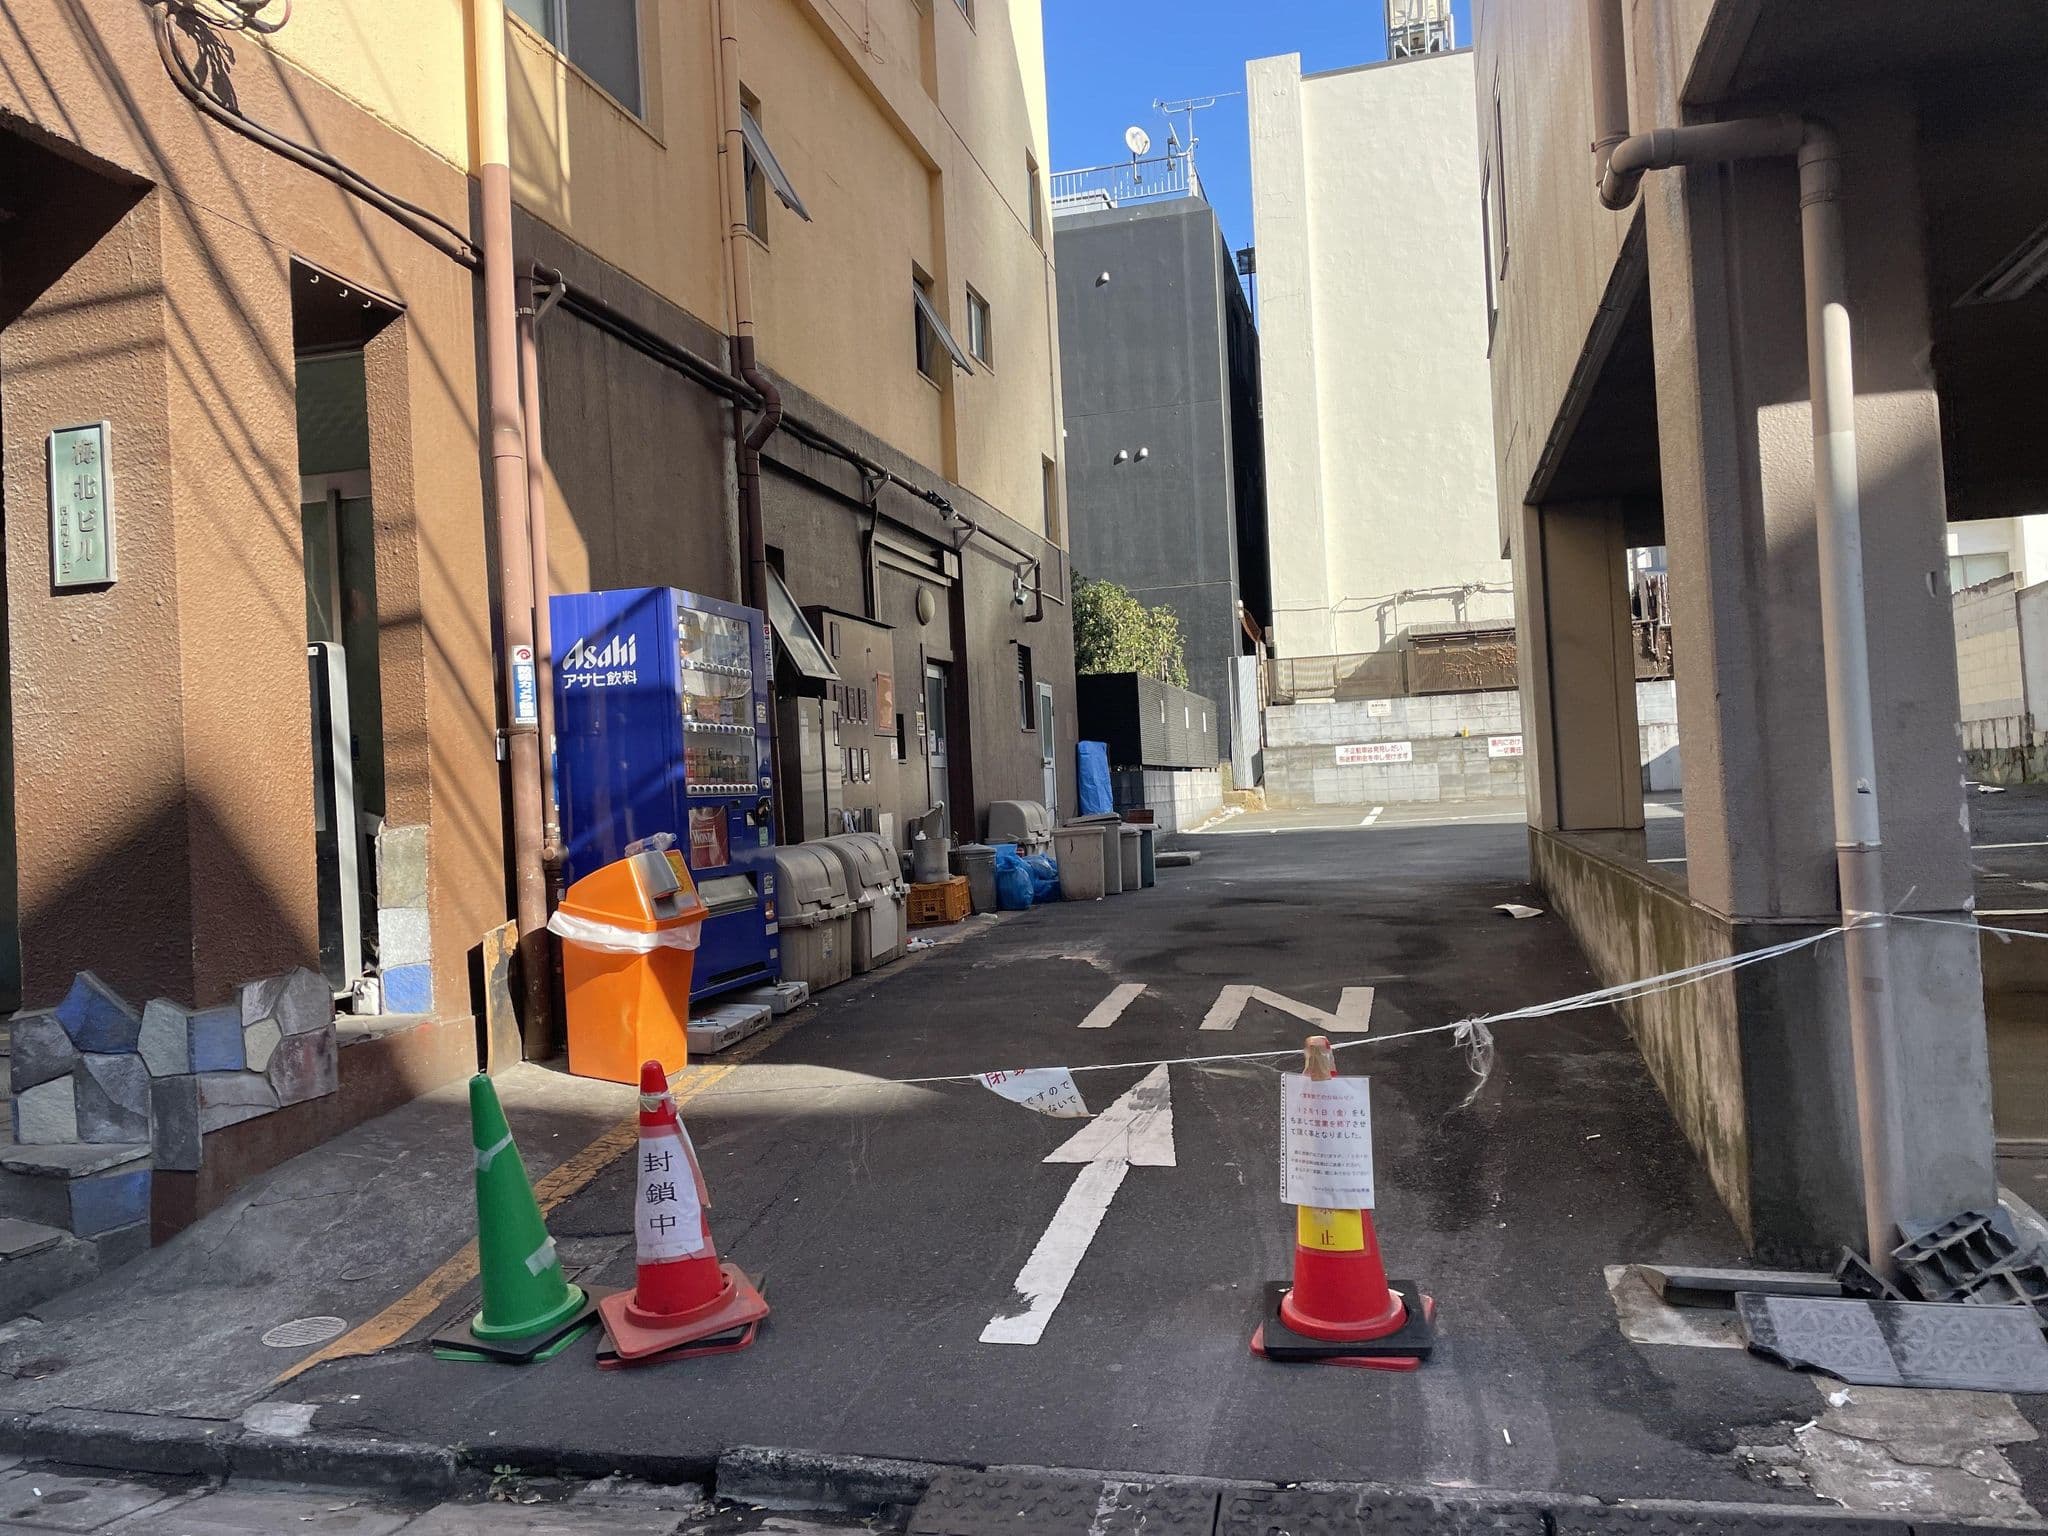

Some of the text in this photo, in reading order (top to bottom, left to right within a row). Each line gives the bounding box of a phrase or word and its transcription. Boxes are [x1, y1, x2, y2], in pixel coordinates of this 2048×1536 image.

[562, 634, 637, 671] Asahi
[562, 670, 638, 689] アサヒ飲料
[1077, 983, 1375, 1032] IN
[643, 1150, 678, 1236] 封鎖中
